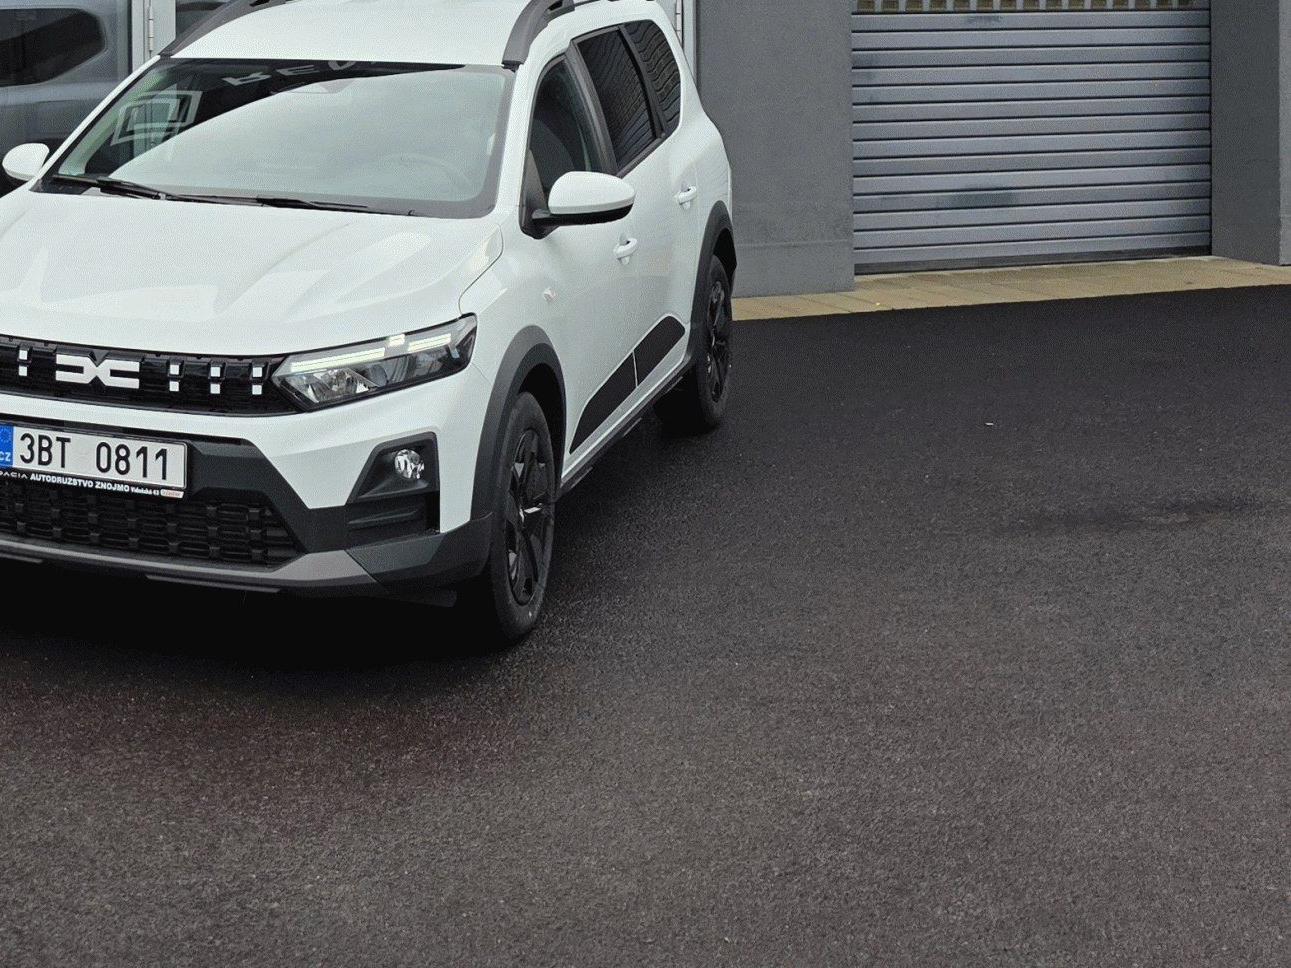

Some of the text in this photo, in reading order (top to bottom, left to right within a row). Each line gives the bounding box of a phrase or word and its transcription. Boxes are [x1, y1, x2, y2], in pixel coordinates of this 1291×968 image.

[19, 432, 71, 469] 3BT
[96, 441, 168, 481] 0811
[95, 481, 130, 493] ZNOJMO
